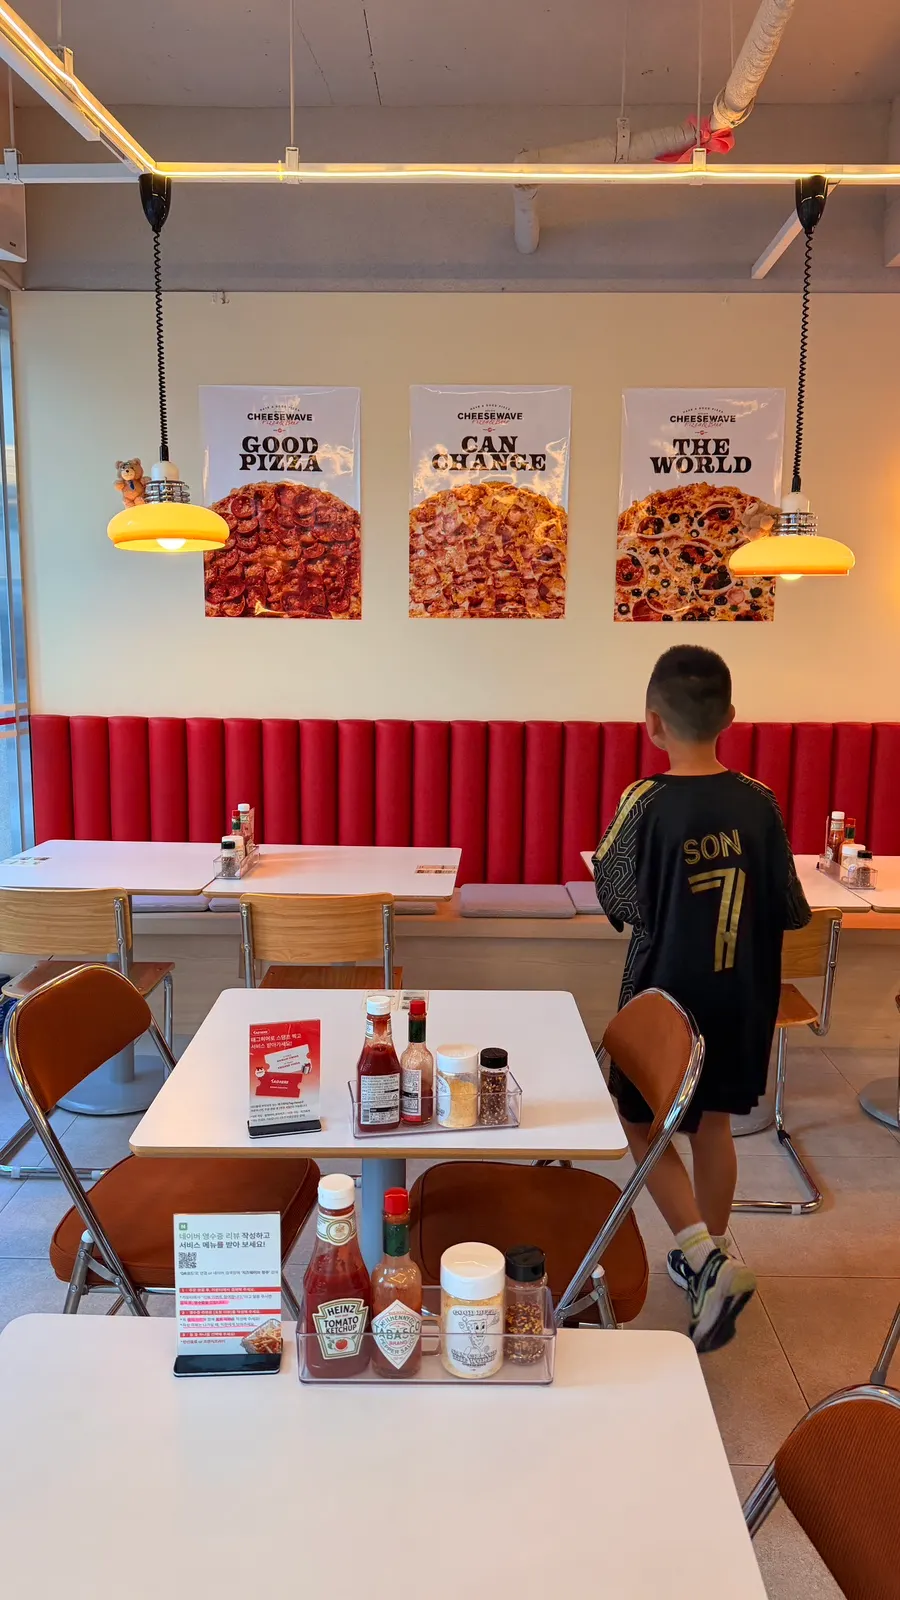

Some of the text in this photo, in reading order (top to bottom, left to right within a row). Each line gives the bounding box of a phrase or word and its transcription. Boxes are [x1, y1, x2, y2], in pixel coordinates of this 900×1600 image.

[247, 412, 313, 421] CHEESEWAVE
[457, 412, 523, 420] CHEESEWAVE
[670, 415, 736, 423] CHEESEWAVE
[242, 436, 319, 454] GOOD
[461, 436, 518, 453] CAN
[673, 438, 730, 456] THE
[239, 453, 323, 472] PIZZA
[432, 453, 546, 471] CHANGE
[650, 456, 752, 474] WORLD
[683, 829, 743, 865] SON
[687, 867, 746, 972] 7
[179, 1232, 200, 1240] 네이버
[202, 1232, 224, 1240] 영수증
[225, 1232, 240, 1240] 리뷰
[179, 1241, 201, 1249] 서비스
[202, 1241, 224, 1249] 메뉴를
[241, 1240, 266, 1248] 보세요!
[327, 1305, 356, 1316] HEINZ
[324, 1316, 359, 1328] TOMATO
[326, 1324, 357, 1334] KETCHUP
[374, 1320, 420, 1340] TABASCO
